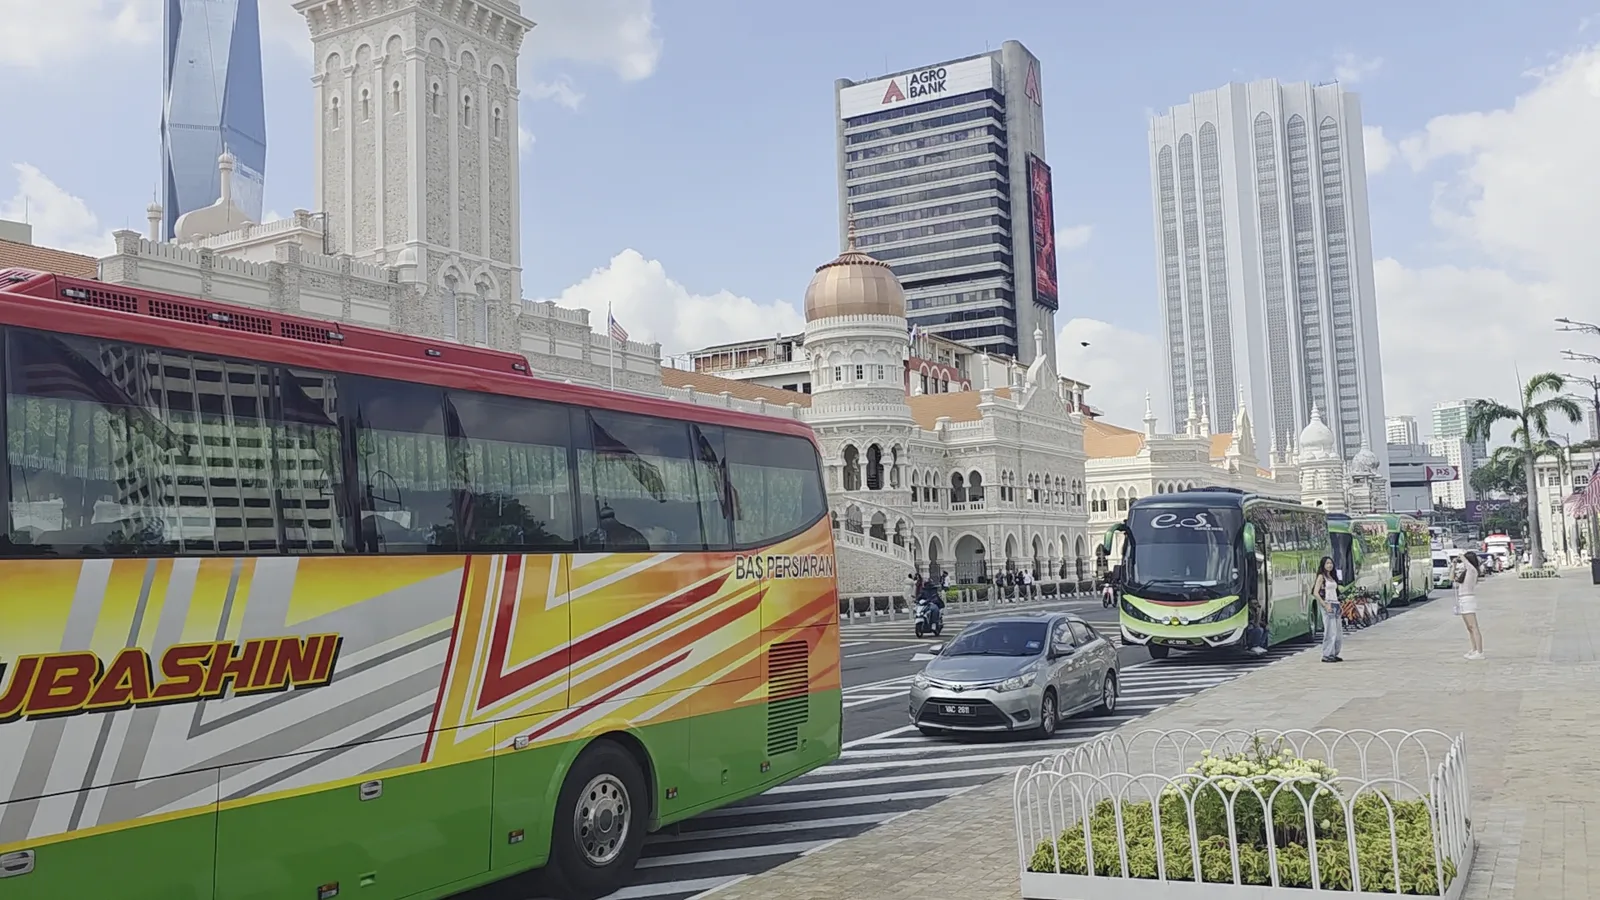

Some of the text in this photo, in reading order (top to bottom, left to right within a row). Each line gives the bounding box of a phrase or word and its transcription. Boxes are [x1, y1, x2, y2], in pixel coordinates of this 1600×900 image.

[910, 68, 947, 86] AGRO
[910, 80, 947, 98] BANK
[735, 554, 834, 580] BAS PERSIARAN
